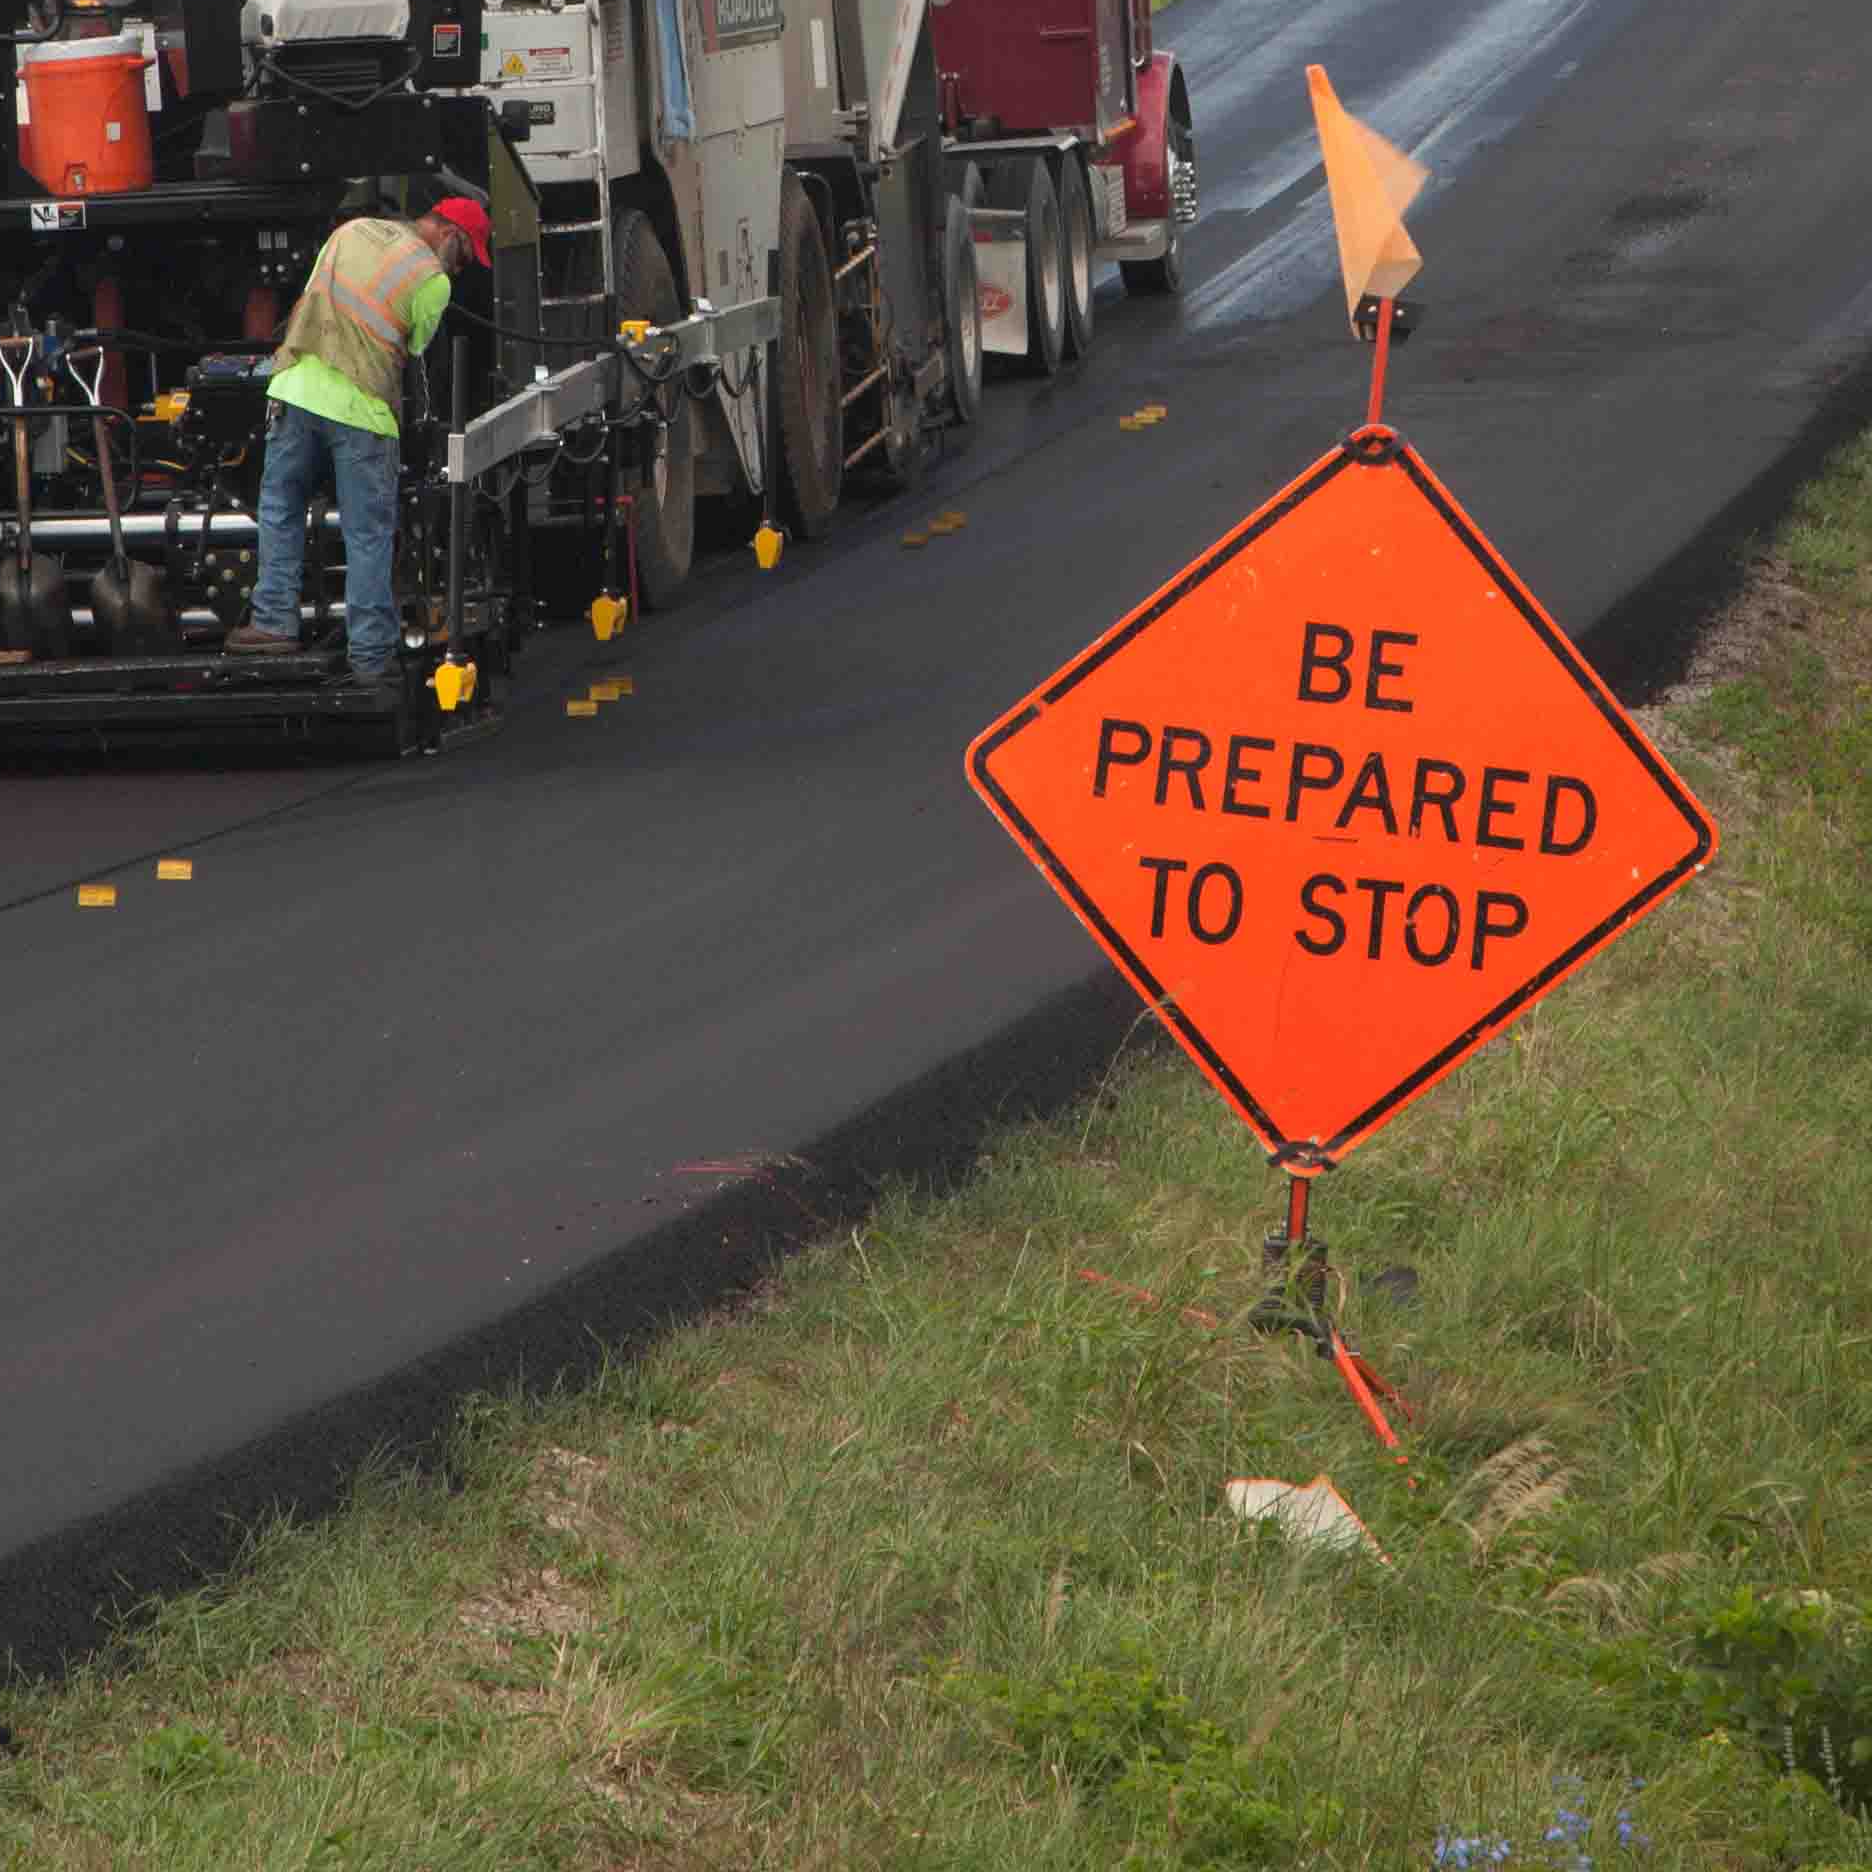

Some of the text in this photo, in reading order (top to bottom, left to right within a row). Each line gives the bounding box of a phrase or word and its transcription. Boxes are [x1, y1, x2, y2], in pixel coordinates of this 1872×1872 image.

[1296, 621, 1420, 714] BE
[1091, 718, 1598, 857] PREPARED
[1138, 856, 1530, 972] TO STOP
